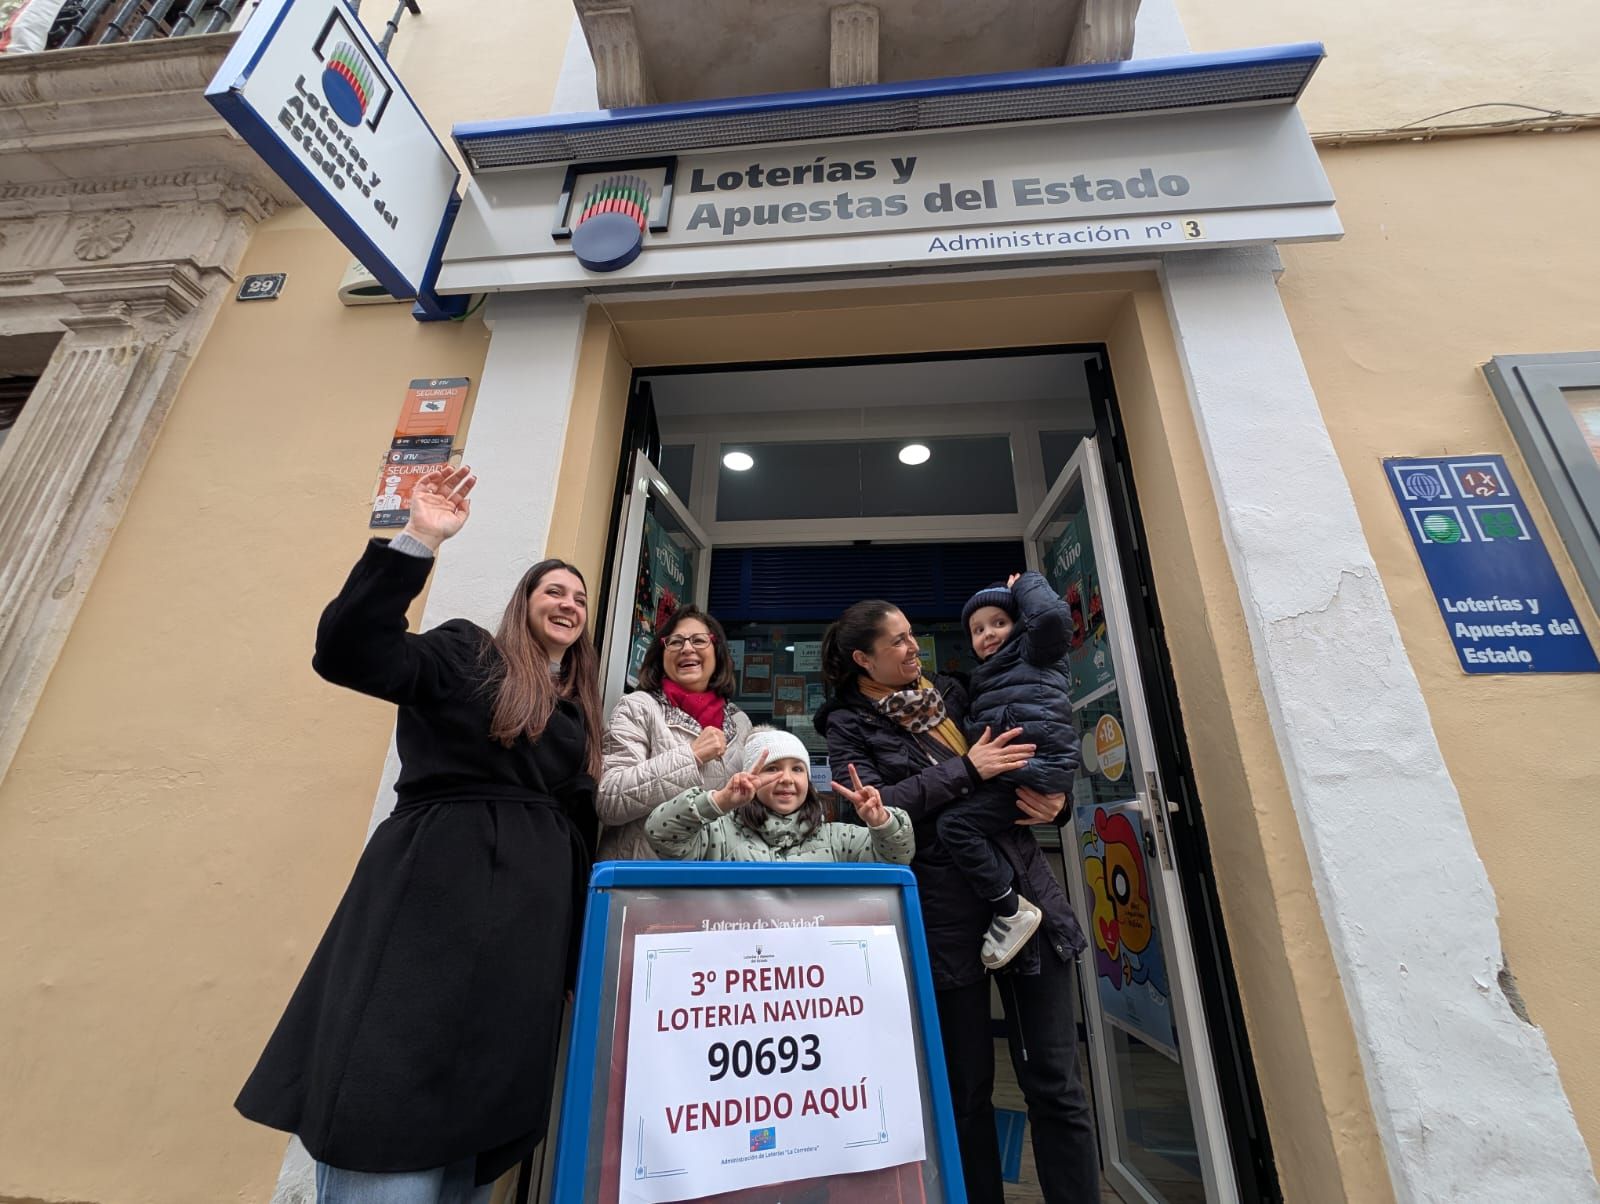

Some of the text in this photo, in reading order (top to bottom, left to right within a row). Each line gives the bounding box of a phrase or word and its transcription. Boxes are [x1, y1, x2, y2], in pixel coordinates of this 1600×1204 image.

[277, 106, 346, 190] Estado
[286, 95, 399, 230] Apuestas del
[368, 171, 381, 188] y
[690, 156, 917, 193] Loterías y
[686, 168, 1190, 235] Apuestas del Estado
[928, 225, 1130, 253] Administración
[1188, 220, 1201, 238] 3
[248, 280, 272, 293] 29
[388, 465, 443, 475] SEGURIDAD
[1442, 595, 1540, 615] Loterías y
[1455, 618, 1581, 642] Apuestas del
[1463, 646, 1533, 664] Estado
[753, 918, 769, 930] de
[770, 914, 825, 928] Navidad
[725, 964, 825, 994] PREMIO
[657, 995, 864, 1032] LOTERIA NAVIDAD
[708, 1033, 822, 1082] 90693
[665, 1077, 868, 1135] VENDIDO AQUÍ
